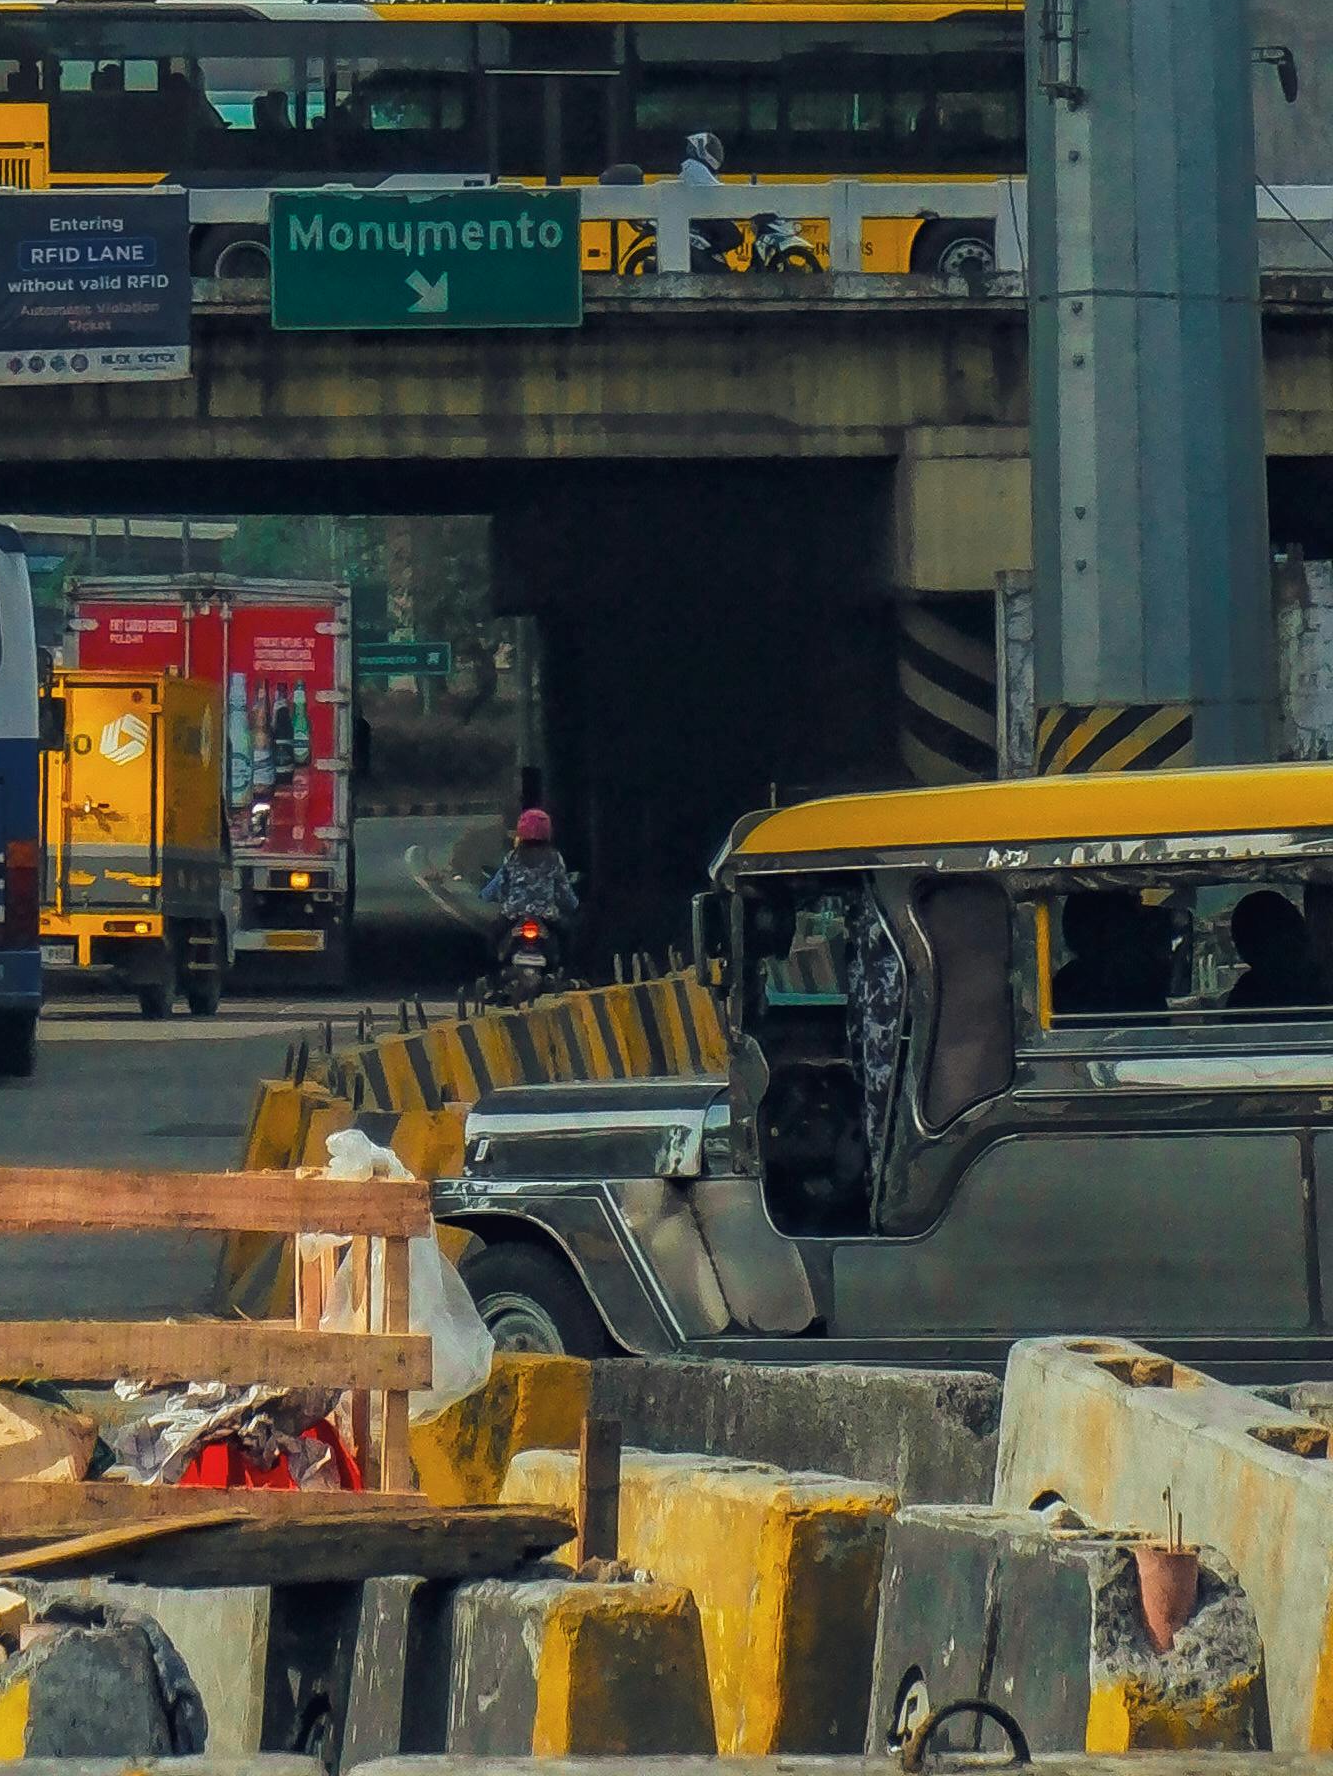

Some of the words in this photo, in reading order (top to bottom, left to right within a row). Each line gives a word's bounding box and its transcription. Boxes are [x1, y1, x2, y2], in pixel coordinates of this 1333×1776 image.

[48, 215, 125, 233] Entering
[289, 211, 564, 257] Monumento
[30, 247, 81, 264] RFID
[87, 244, 145, 262] LANE
[7, 277, 75, 294] without
[79, 275, 122, 290] valid
[127, 273, 170, 289] RFID
